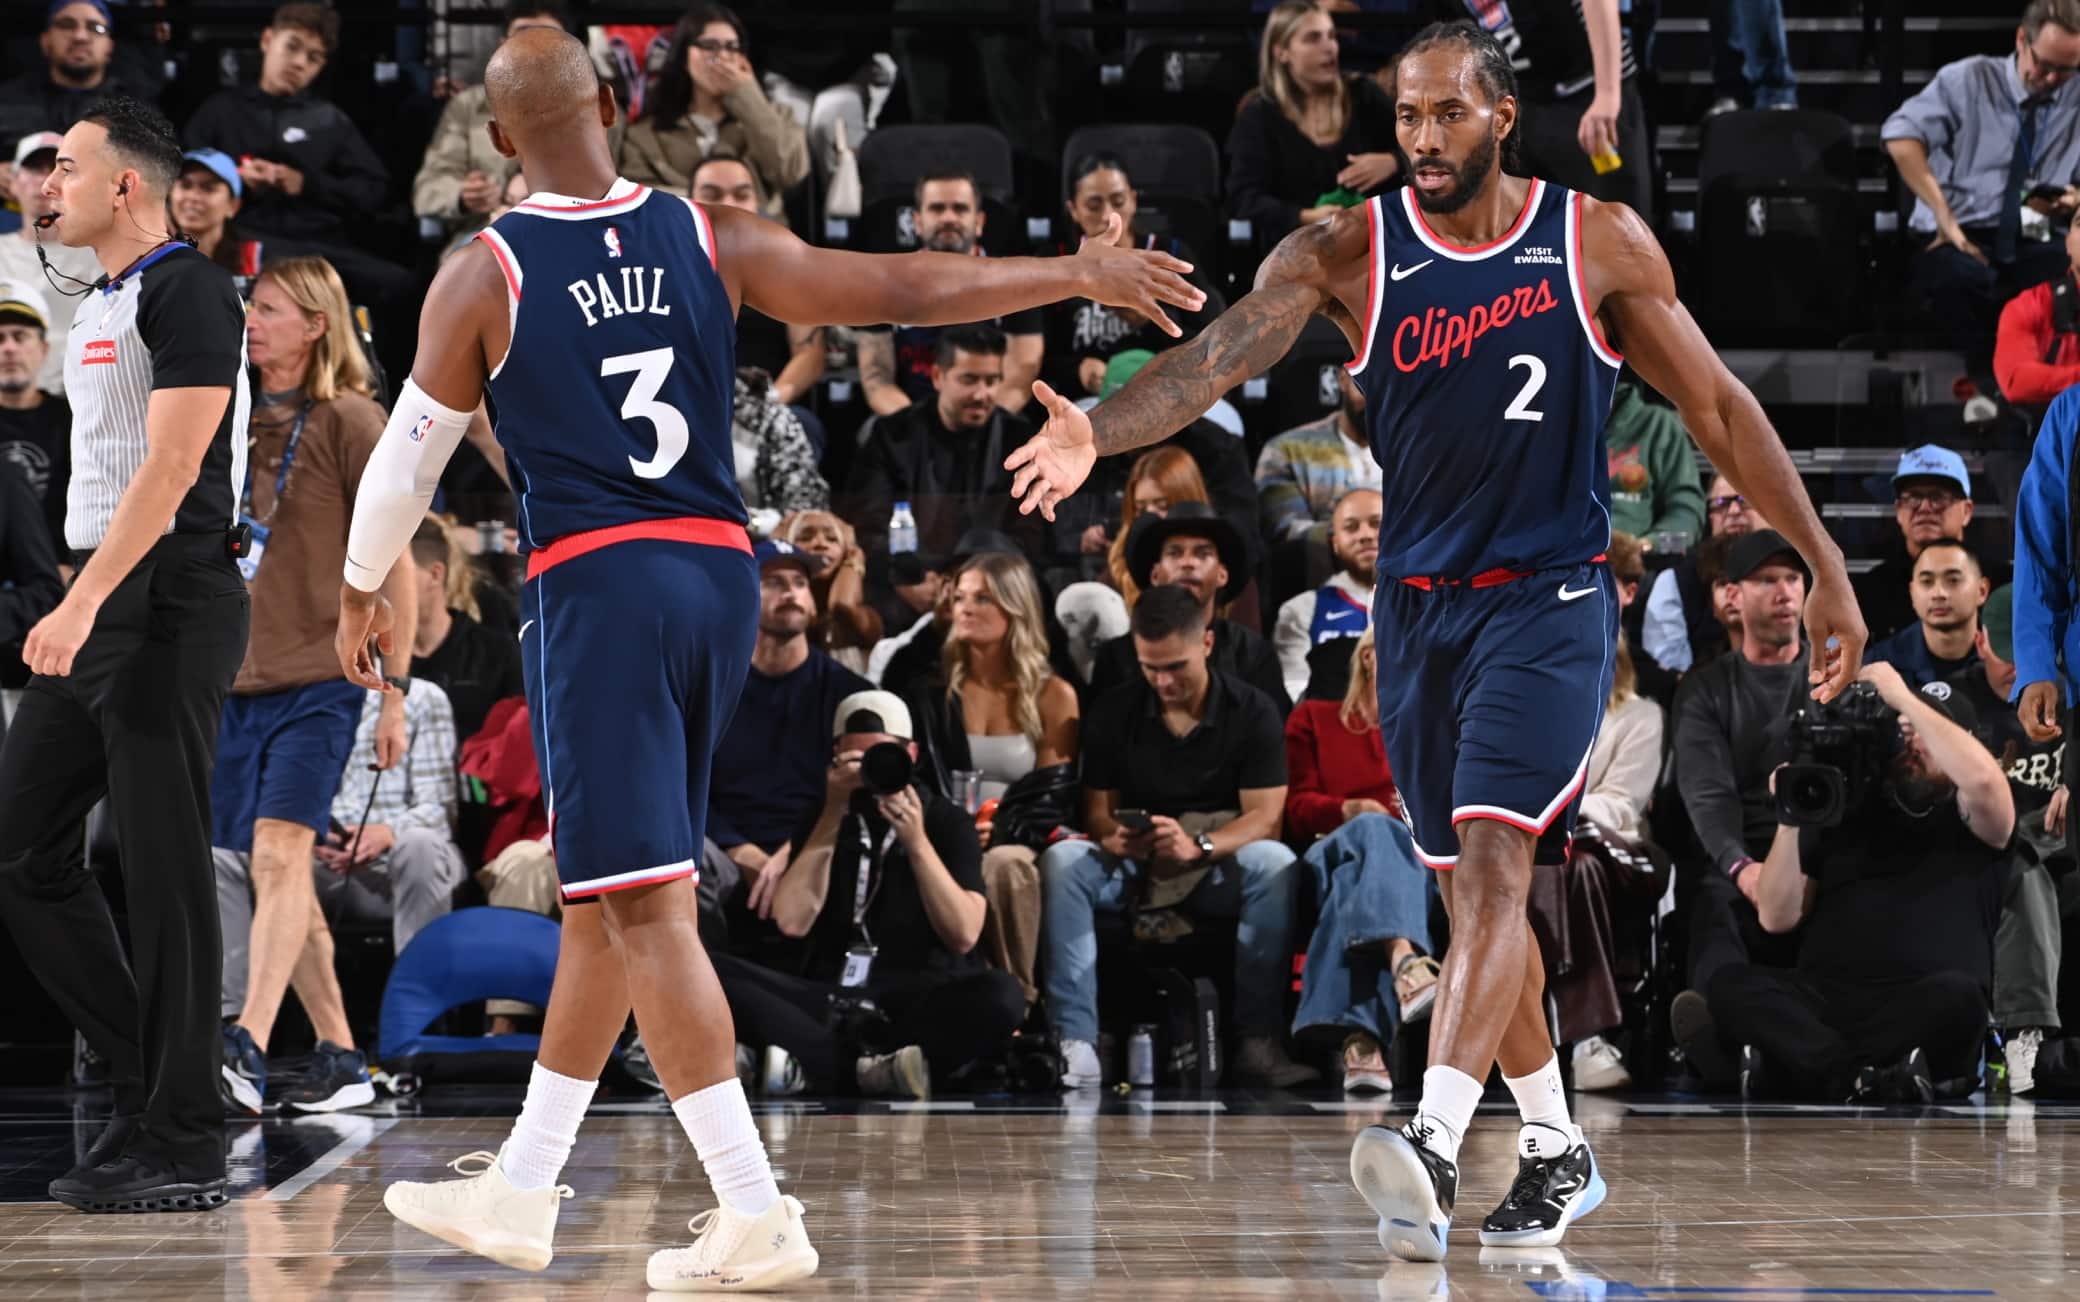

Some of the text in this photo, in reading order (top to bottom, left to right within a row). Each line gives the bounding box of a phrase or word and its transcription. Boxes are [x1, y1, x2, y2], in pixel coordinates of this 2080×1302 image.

[1513, 255, 1563, 265] RWANDA
[1524, 246, 1553, 256] VISIT
[567, 266, 671, 328] PAUL
[1392, 278, 1559, 373] Clippers
[600, 346, 690, 480] 3
[1503, 353, 1548, 422] 2
